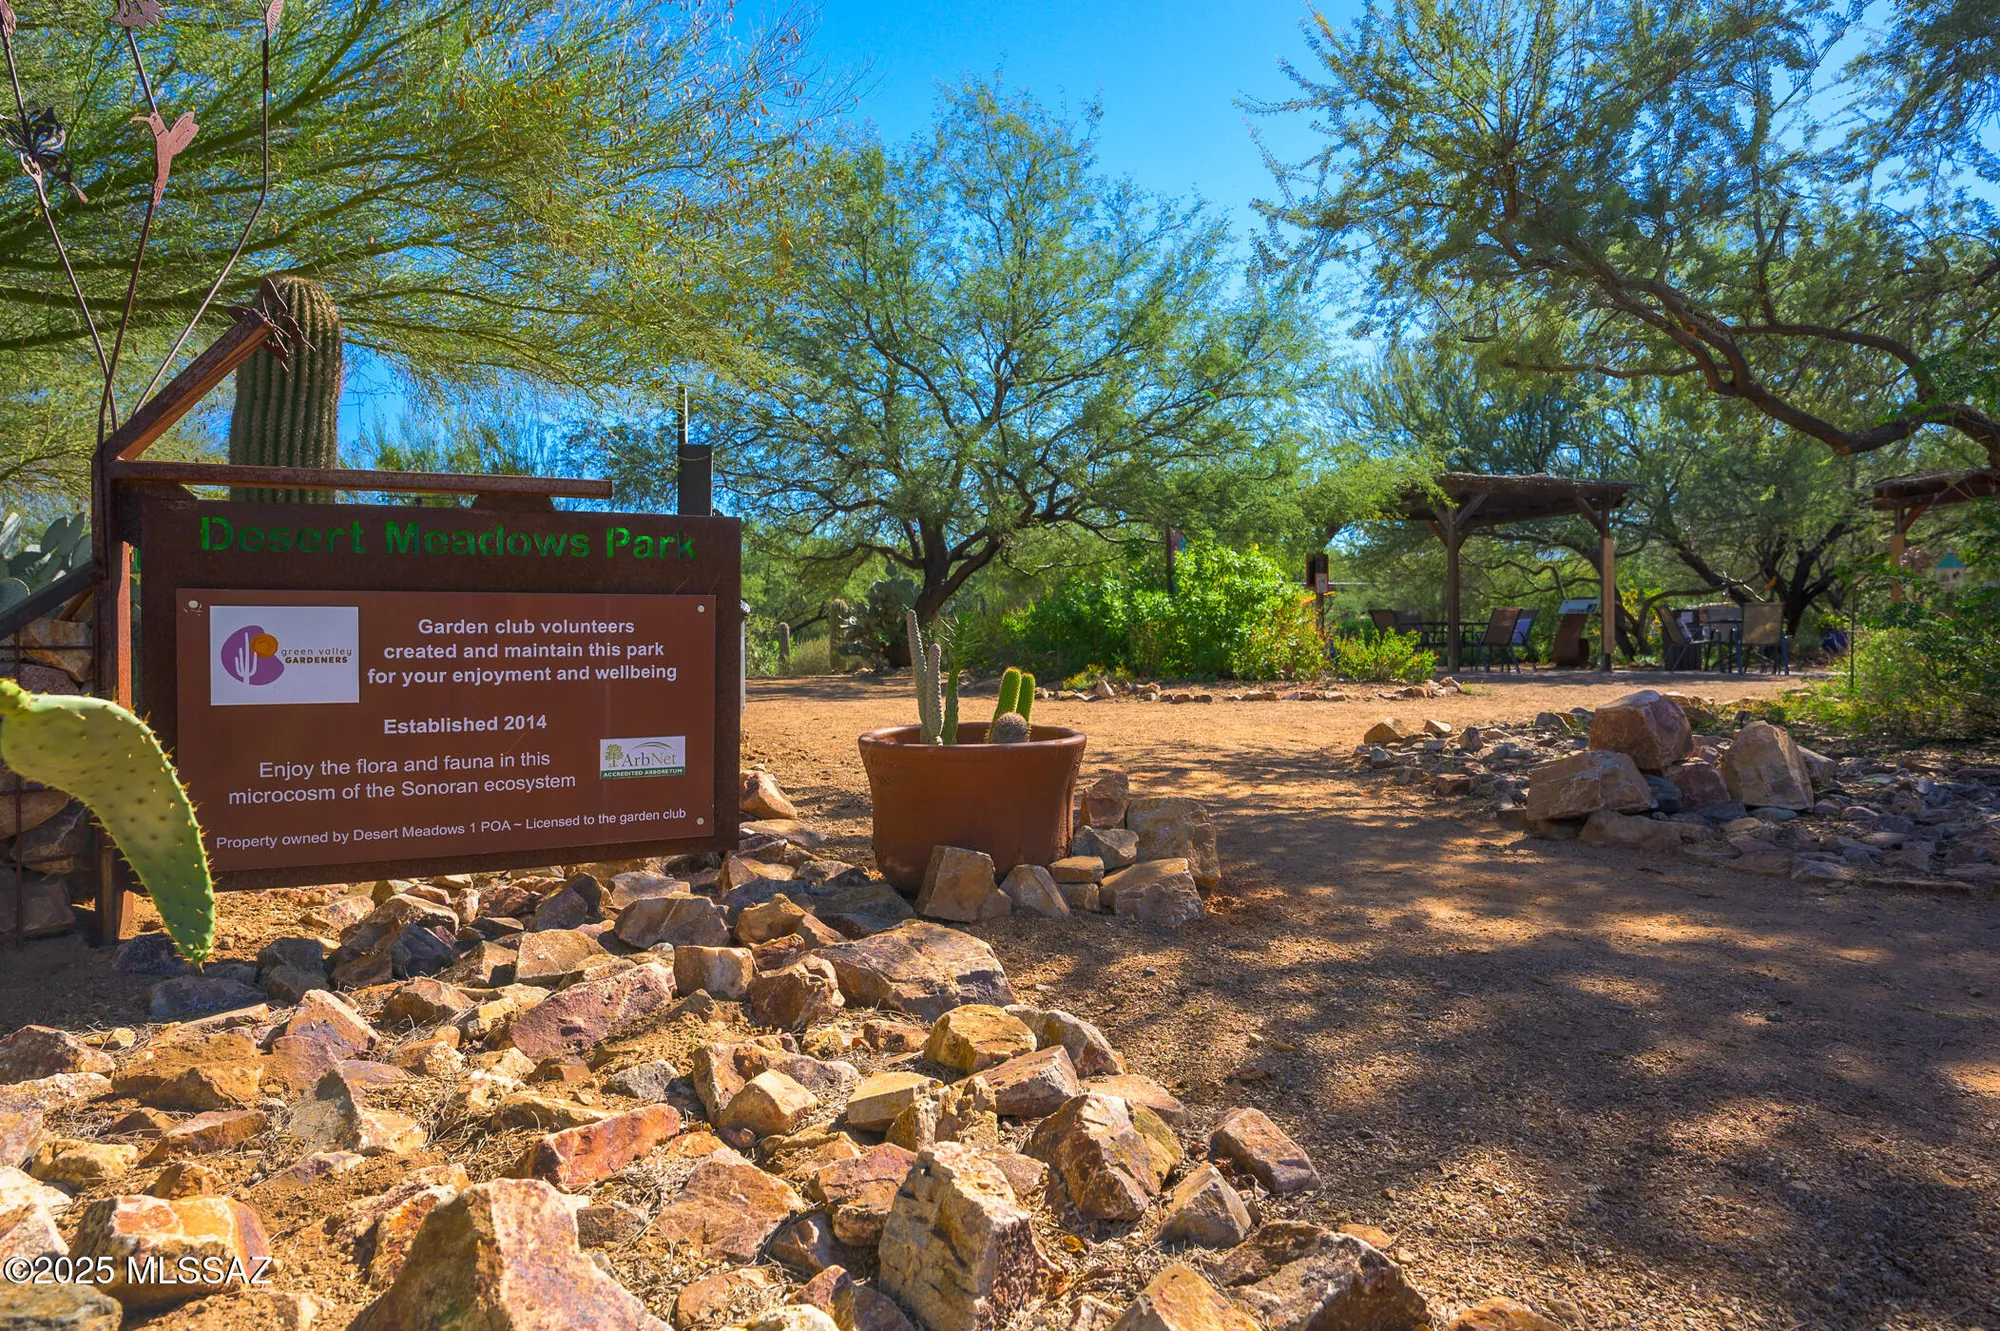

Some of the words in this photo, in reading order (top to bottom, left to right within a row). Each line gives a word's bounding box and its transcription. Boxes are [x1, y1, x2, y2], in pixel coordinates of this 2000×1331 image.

[200, 517, 366, 554] Desert
[386, 522, 590, 558] Meadows
[606, 527, 698, 560] Park
[418, 619, 488, 634] Garden
[495, 619, 535, 633] club
[541, 619, 634, 633] volunteers
[281, 648, 313, 657] green
[318, 647, 352, 657] valley
[384, 643, 457, 659] created
[463, 643, 499, 658] and
[504, 643, 583, 657] maintain
[589, 642, 621, 656] this
[627, 642, 664, 659] park
[285, 656, 348, 664] GARDENERS
[367, 668, 397, 683] for
[402, 671, 447, 686] your
[452, 666, 551, 686] enjoyment
[557, 666, 590, 681] and
[595, 664, 677, 685] wellbeing
[384, 717, 499, 735] Established
[504, 715, 547, 730] 2014
[260, 761, 313, 781] Enjoy
[321, 759, 350, 775] the
[357, 757, 398, 774] flora
[404, 757, 438, 772] and
[443, 754, 493, 770] fauna
[500, 753, 515, 767] in
[520, 751, 550, 766] this
[623, 752, 677, 768] ArbNet
[645, 768, 684, 776] ARBORETUM
[229, 786, 336, 805] microcosm
[342, 783, 360, 799] of
[366, 782, 395, 798] the
[402, 779, 478, 797] Sonoran
[484, 773, 575, 792] ecosystem
[217, 835, 277, 850] Property
[282, 831, 327, 846] owned
[332, 830, 349, 844] by
[353, 827, 397, 841] Desert
[402, 823, 465, 838] Meadows
[471, 822, 476, 834] 1
[481, 820, 511, 834] POA
[525, 815, 579, 830] Licensed
[584, 814, 595, 826] to
[599, 813, 616, 825] the
[620, 810, 660, 826] garden
[663, 808, 687, 820] club
